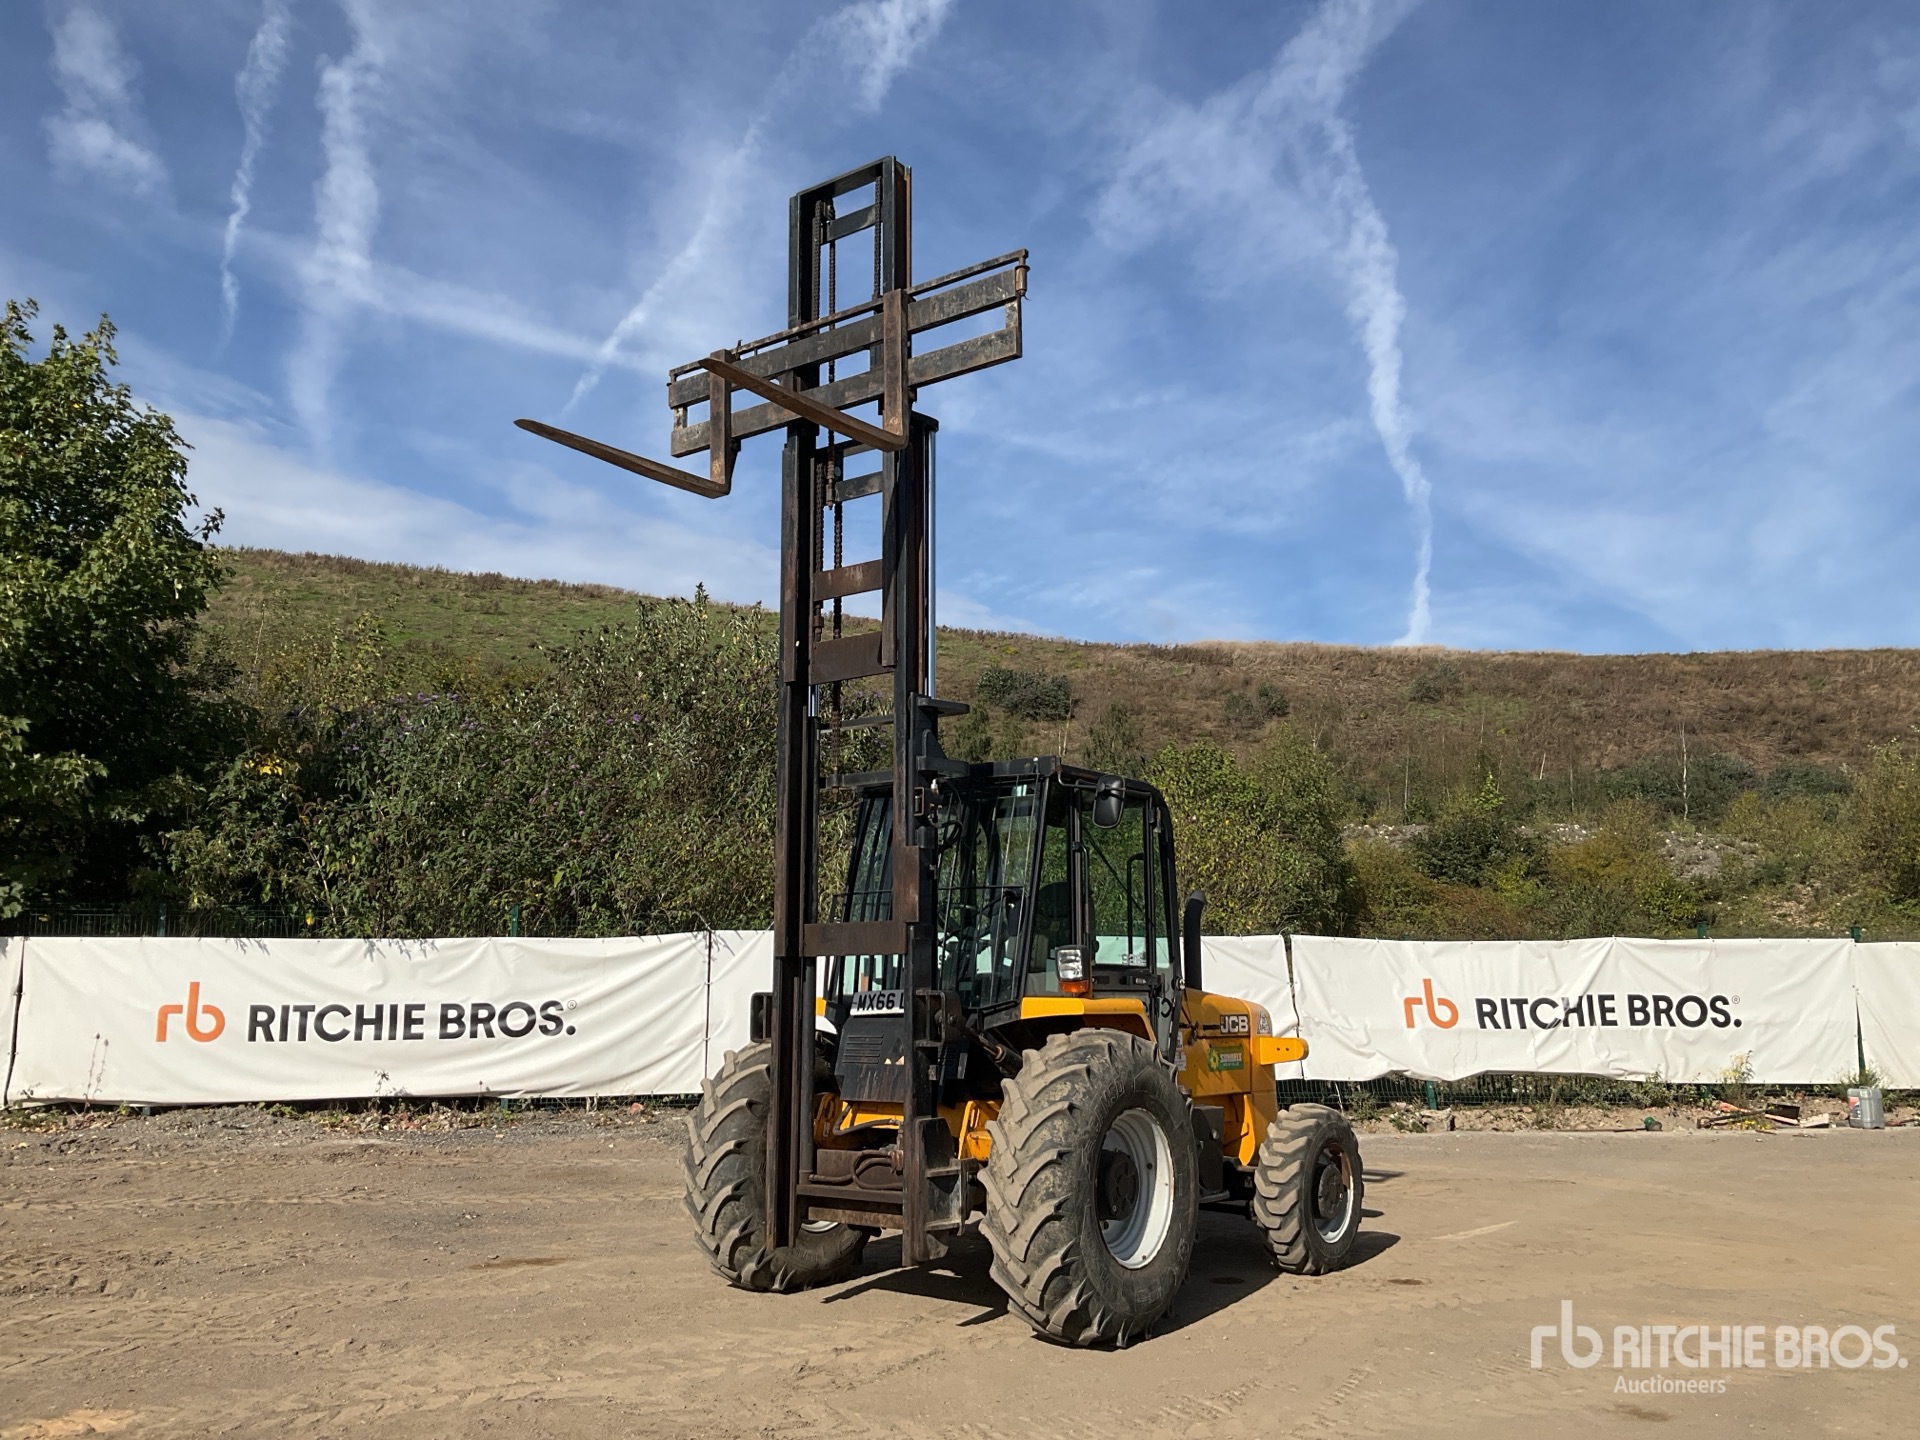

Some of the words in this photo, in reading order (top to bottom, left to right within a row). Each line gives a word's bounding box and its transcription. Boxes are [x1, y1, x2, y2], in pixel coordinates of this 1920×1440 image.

[156, 981, 226, 1043] rb
[249, 1003, 426, 1042] RITCHIE
[438, 1000, 577, 1040] BROS.
[857, 993, 896, 1012] MX66
[1404, 978, 1460, 1029] rb
[1475, 995, 1618, 1030] RITCHIE
[1627, 995, 1743, 1028] BROS.
[1220, 1015, 1249, 1033] JCB
